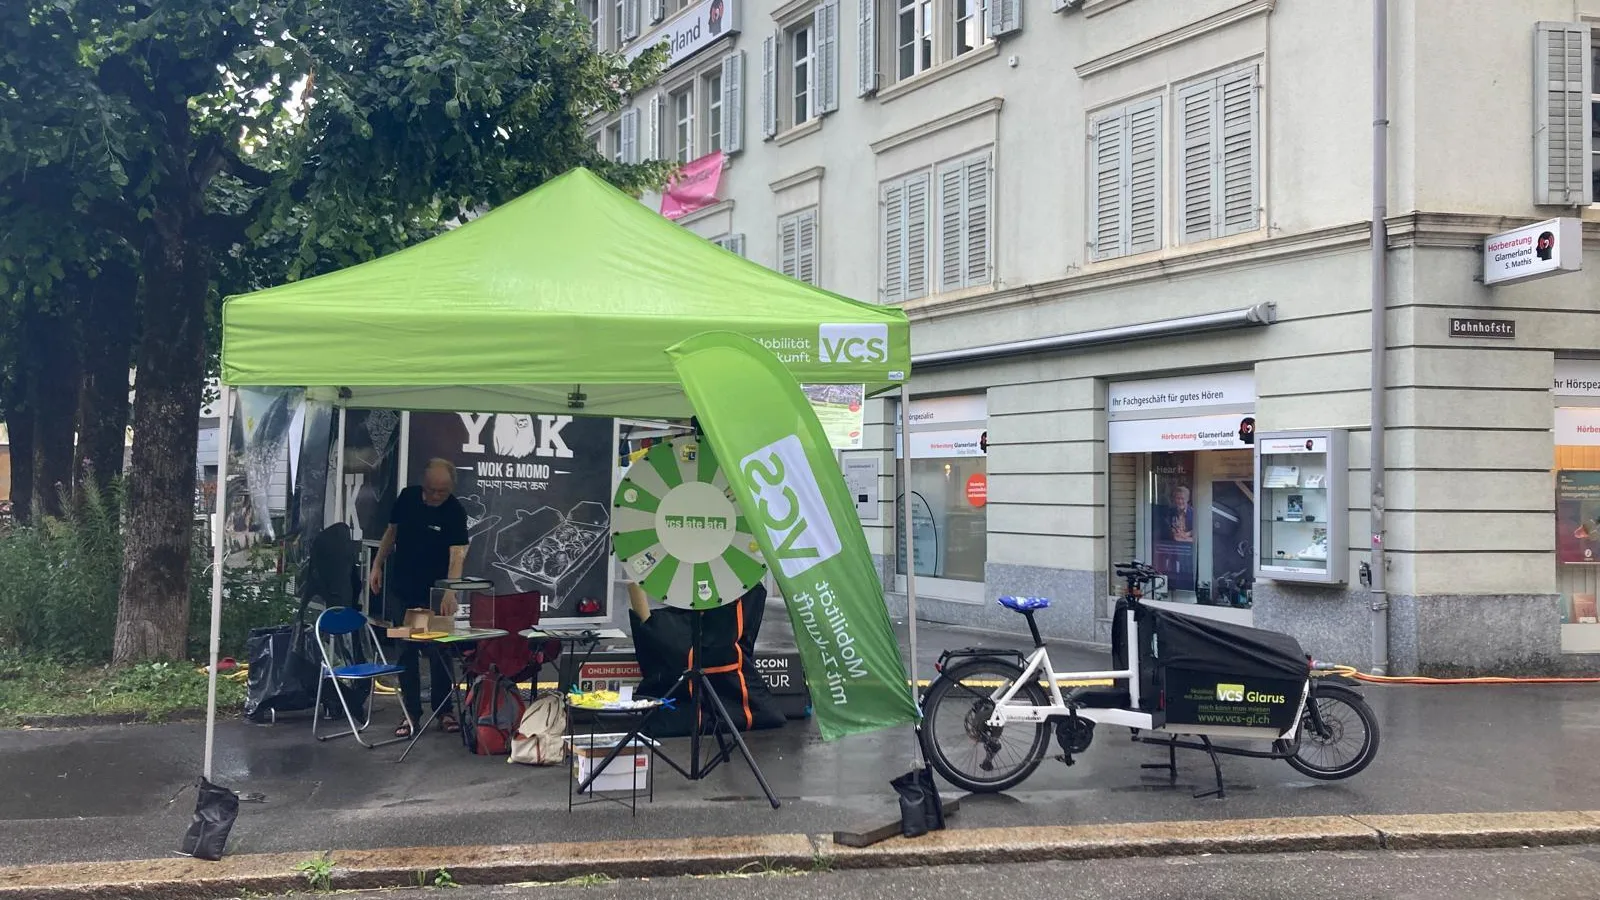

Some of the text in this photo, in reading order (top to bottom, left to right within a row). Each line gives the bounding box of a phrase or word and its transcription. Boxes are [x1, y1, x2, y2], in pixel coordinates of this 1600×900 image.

[1488, 236, 1532, 252] Hörberatung
[1511, 257, 1532, 268] Mathis
[1454, 320, 1513, 333] Bahnhofstr.
[822, 337, 885, 363] VCS
[1554, 379, 1563, 388] hr
[1112, 389, 1224, 406] Ihr Fachgeschäft für gutes Hören
[1198, 430, 1234, 439] Glarnerland
[477, 462, 550, 479] WOK & MOMO
[754, 658, 788, 668] SCONI
[1218, 689, 1243, 701] VCS
[1246, 691, 1285, 704] Glarus
[1198, 713, 1270, 725] www.vcs-gl.ch
